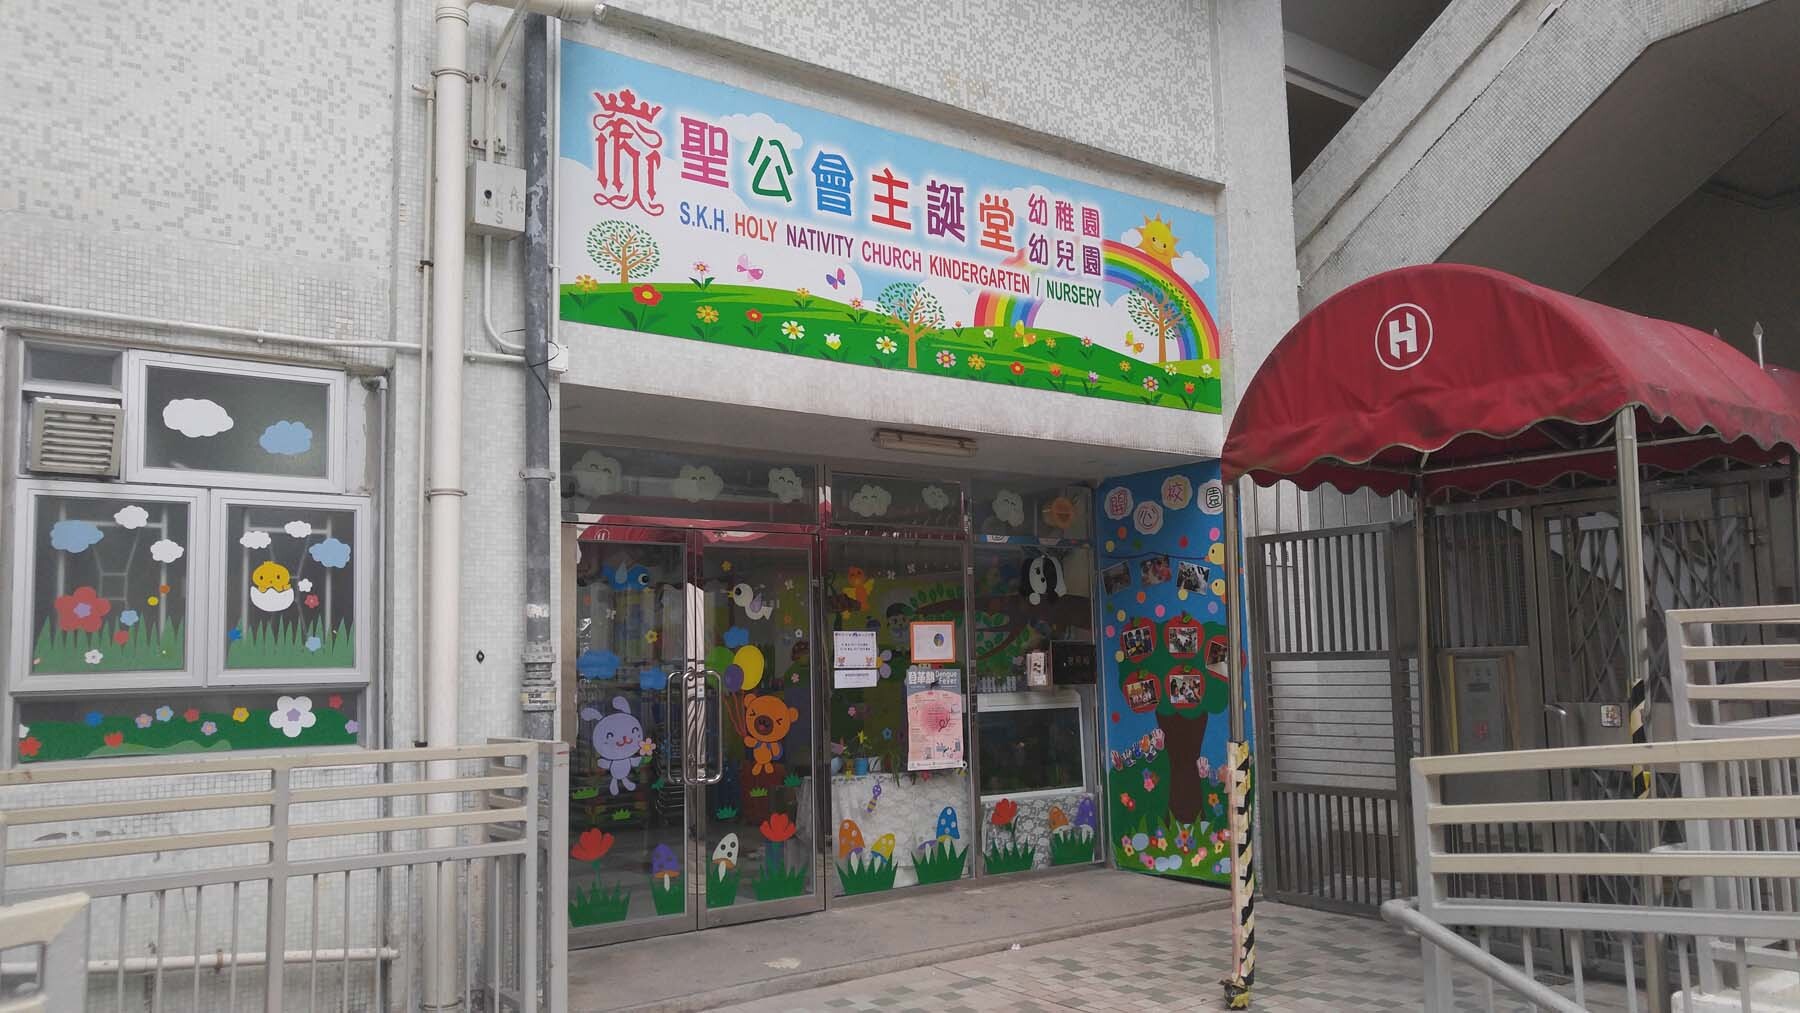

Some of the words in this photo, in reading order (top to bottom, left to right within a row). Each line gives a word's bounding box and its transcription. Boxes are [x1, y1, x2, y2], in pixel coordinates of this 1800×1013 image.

[680, 116, 1015, 252] 聖公會主誕堂
[1028, 193, 1100, 238] 幼稚園
[680, 201, 729, 232] S.K.H.
[735, 213, 778, 242] HOLY
[786, 224, 854, 258] NATIVITY
[862, 240, 922, 272] CHURCH
[930, 255, 1030, 294] KINDERGARTEN
[1046, 279, 1102, 307] NURSERY
[1028, 233, 1101, 276] 幼兒園
[935, 671, 957, 680] Dengue
